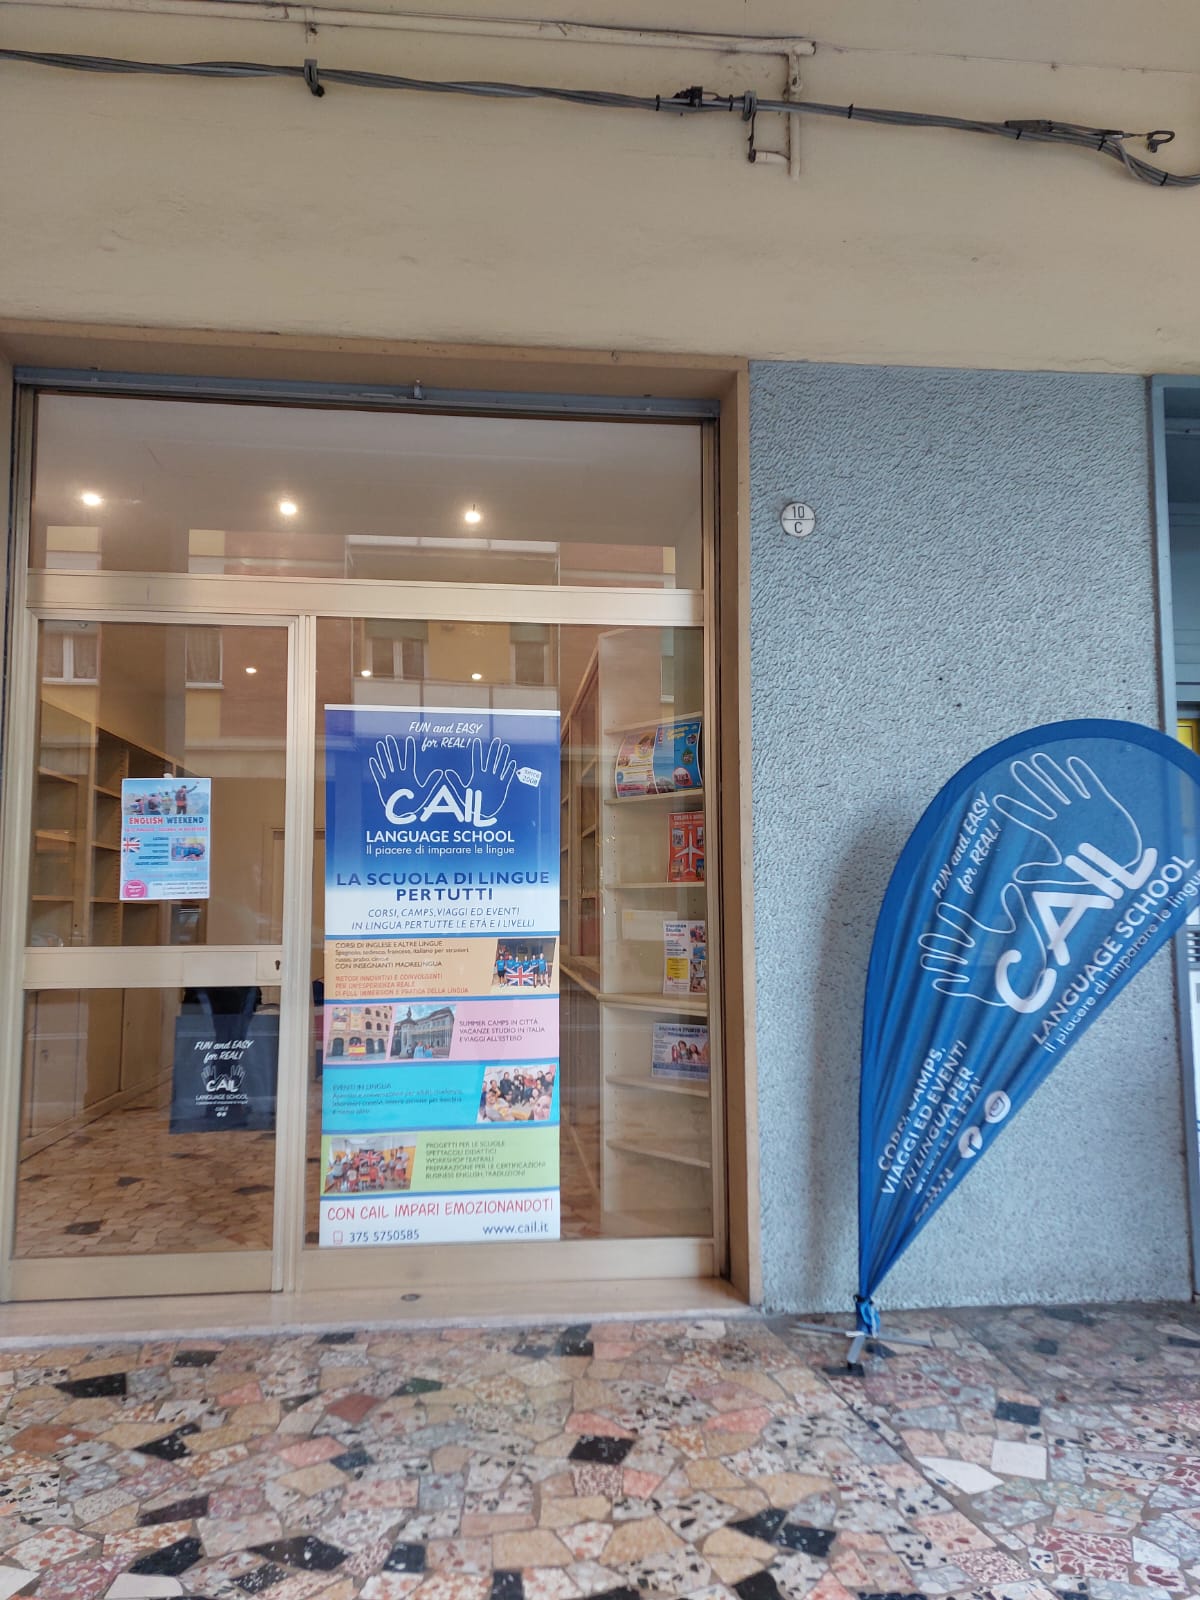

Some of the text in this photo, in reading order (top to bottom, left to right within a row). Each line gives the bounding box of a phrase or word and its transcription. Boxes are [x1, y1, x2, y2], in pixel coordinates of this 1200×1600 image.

[792, 506, 804, 518] 10
[794, 522, 802, 534] C
[409, 722, 483, 734] FUN and EASY
[422, 736, 470, 751] for REAL!
[385, 784, 498, 828] CAIL
[128, 816, 204, 825] ENGLISH WEEKEND
[366, 830, 514, 843] LANGUAGE SCHOOL
[366, 844, 514, 858] Il piacere di imparare le lingue
[932, 792, 990, 898] FUN and EASY
[957, 819, 1002, 894] for REAL!
[337, 871, 550, 886] LA SCUOLA DI LINGUE
[368, 907, 520, 918] CORSI, CAMPS, VIAGGI ED EVENTI
[352, 921, 363, 930] IN
[365, 920, 402, 930] LINGUA
[405, 920, 422, 929] PER
[423, 920, 454, 929] TUTTE
[456, 920, 467, 929] LE
[490, 920, 496, 928] E
[503, 919, 535, 928] LIVELLI
[996, 842, 1158, 1014] CAIL
[1032, 856, 1195, 1045] LANGUAGE SCHOOL
[1056, 996, 1096, 1046] piacere
[1094, 980, 1109, 995] di
[1105, 924, 1158, 980] imparare
[1152, 910, 1172, 922] le
[194, 1040, 255, 1050] FUN and EASY
[203, 1051, 244, 1064] for REAL!
[206, 1078, 238, 1092] CAIL
[882, 1132, 918, 1195] VIAGGI
[913, 1106, 933, 1130] ED
[927, 1040, 968, 1105] EVENTI
[903, 1165, 917, 1190] IN
[916, 1105, 955, 1169] LINGUA
[948, 1067, 975, 1109] PER
[327, 1198, 553, 1221] CON CAIL IMPARI EMOZIONANDOTI
[482, 1221, 548, 1235] www.cail.it
[349, 1230, 420, 1242] 375 5750585
